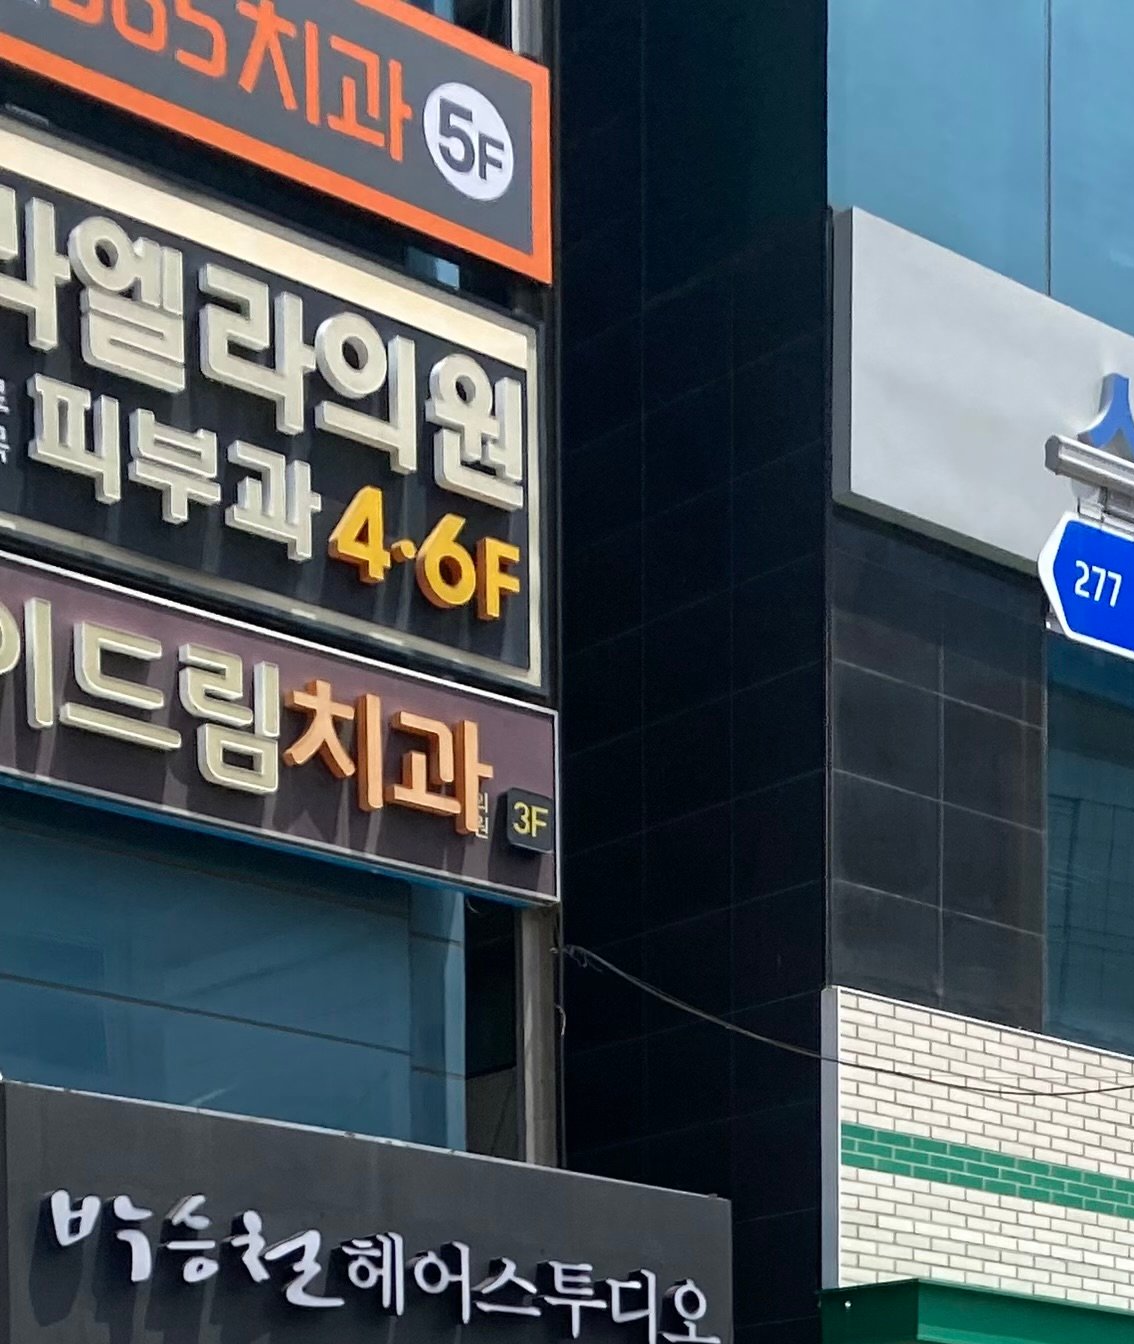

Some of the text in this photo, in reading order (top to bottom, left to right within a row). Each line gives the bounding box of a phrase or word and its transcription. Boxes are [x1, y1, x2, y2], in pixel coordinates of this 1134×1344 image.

[48, 0, 505, 181] 5치과 5F
[28, 371, 322, 563] 피부과
[1073, 559, 1123, 608] 277
[512, 801, 549, 838] 3F
